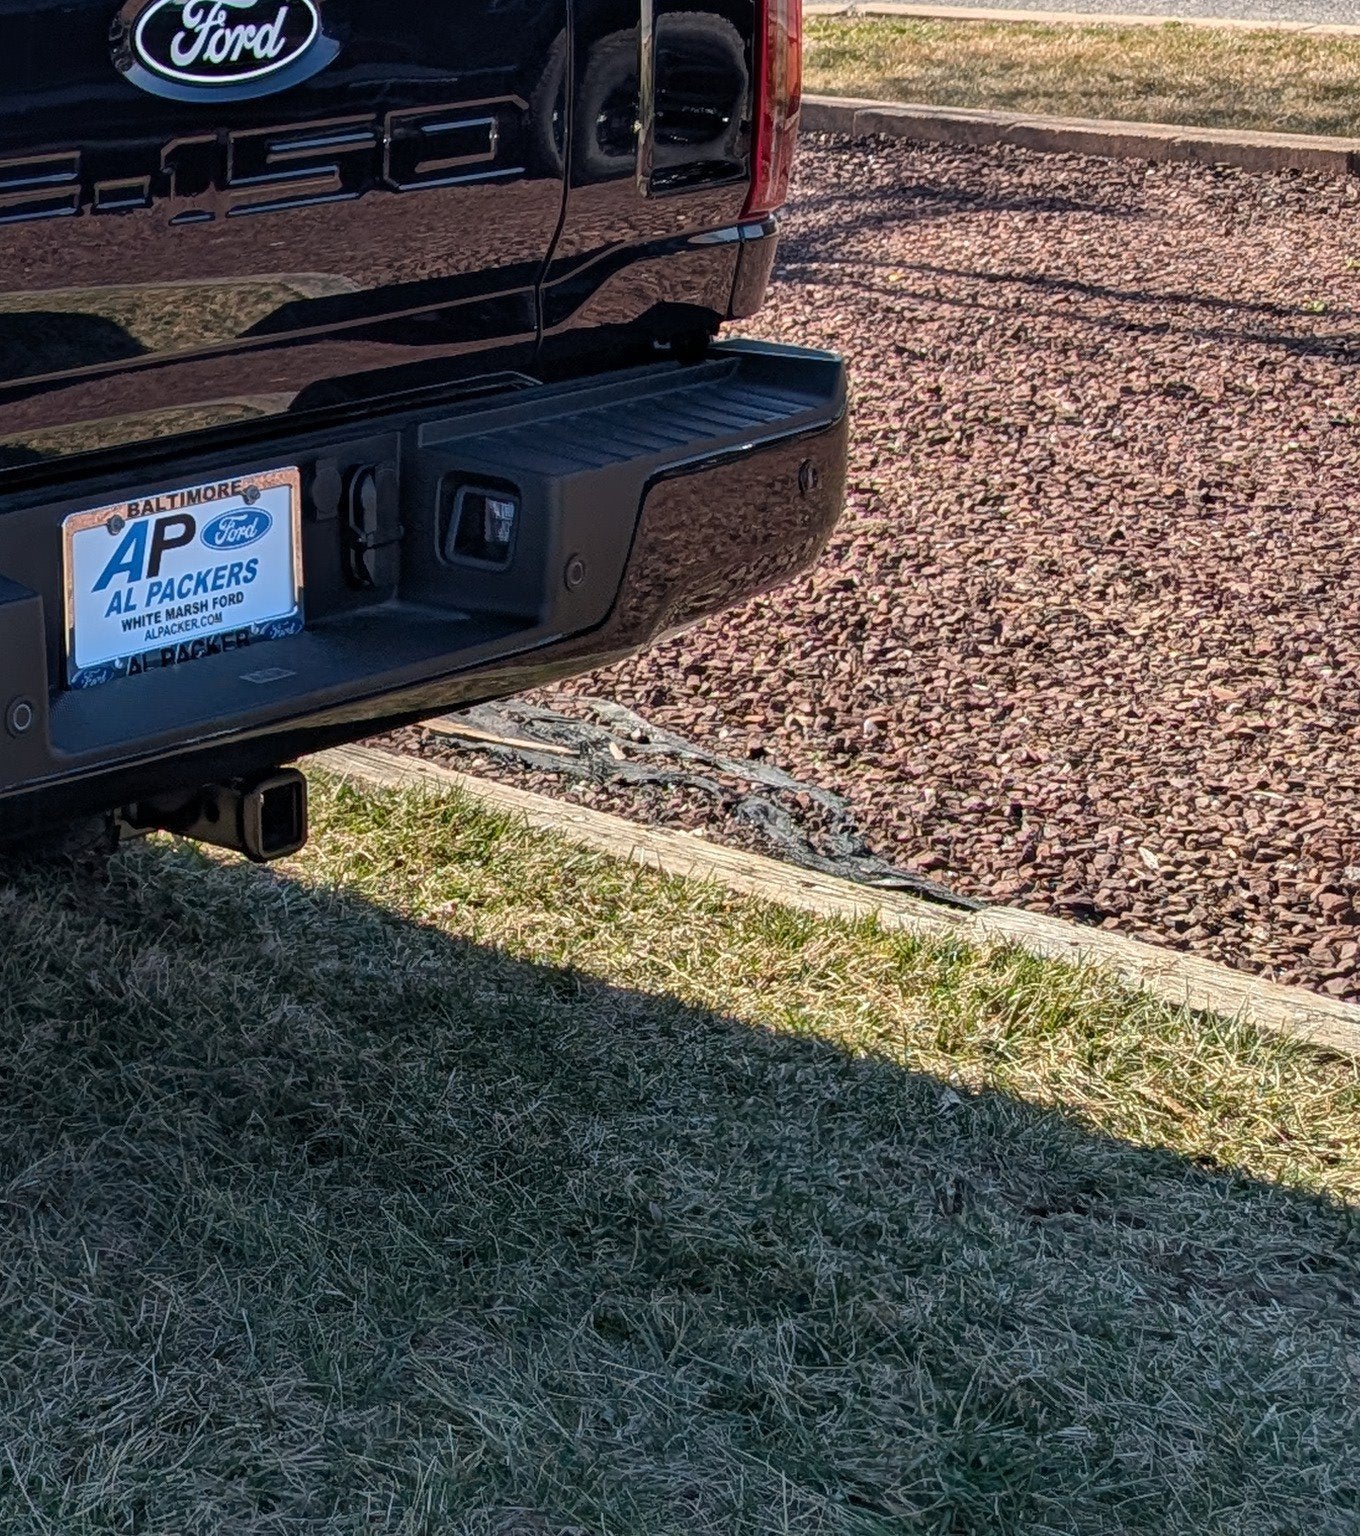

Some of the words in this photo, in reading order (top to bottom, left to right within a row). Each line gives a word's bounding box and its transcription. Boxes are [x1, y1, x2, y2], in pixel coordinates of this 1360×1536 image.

[127, 479, 244, 517] BALTIMORE
[214, 514, 258, 544] Ford
[91, 513, 196, 593] AP
[104, 586, 137, 618] AL
[145, 557, 259, 607] PACKERS
[121, 610, 162, 632] WHITE
[165, 599, 209, 621] MARSH
[212, 591, 245, 610] FORD
[144, 611, 223, 641] ALPACKER.COM
[160, 628, 251, 668] PACKER
